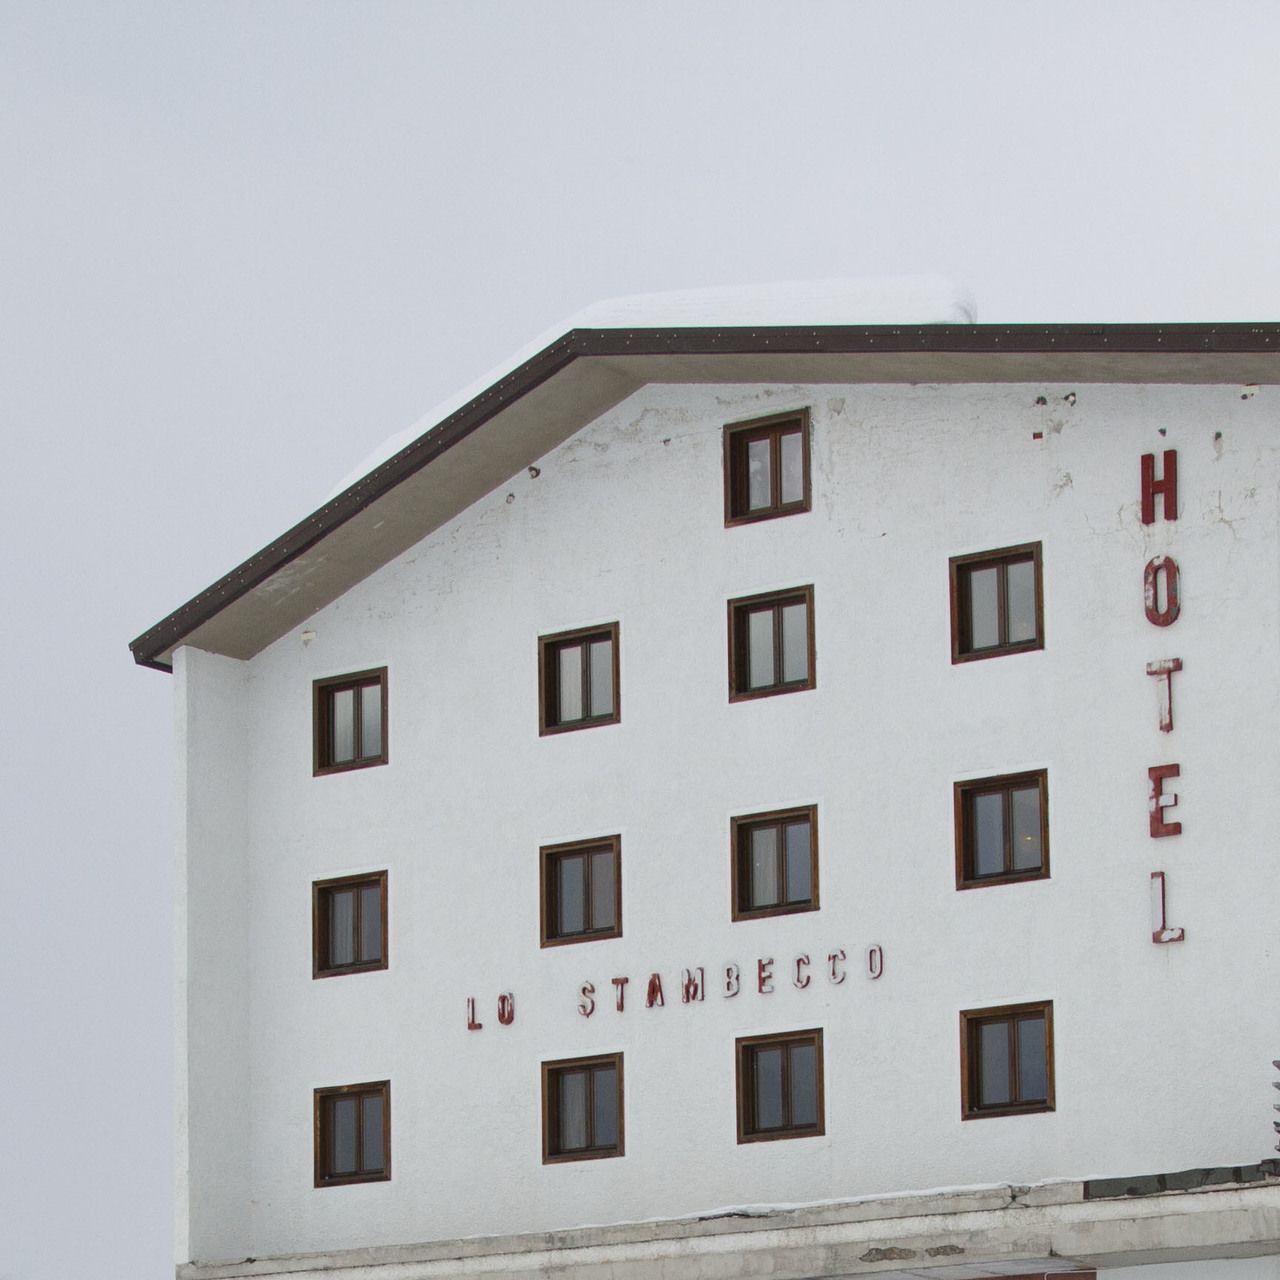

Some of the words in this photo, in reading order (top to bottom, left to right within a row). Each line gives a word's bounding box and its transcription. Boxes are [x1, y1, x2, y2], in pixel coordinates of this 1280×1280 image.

[1140, 448, 1186, 945] HOTEL
[466, 991, 516, 1031] LO
[577, 943, 886, 1018] STAMBECCO
